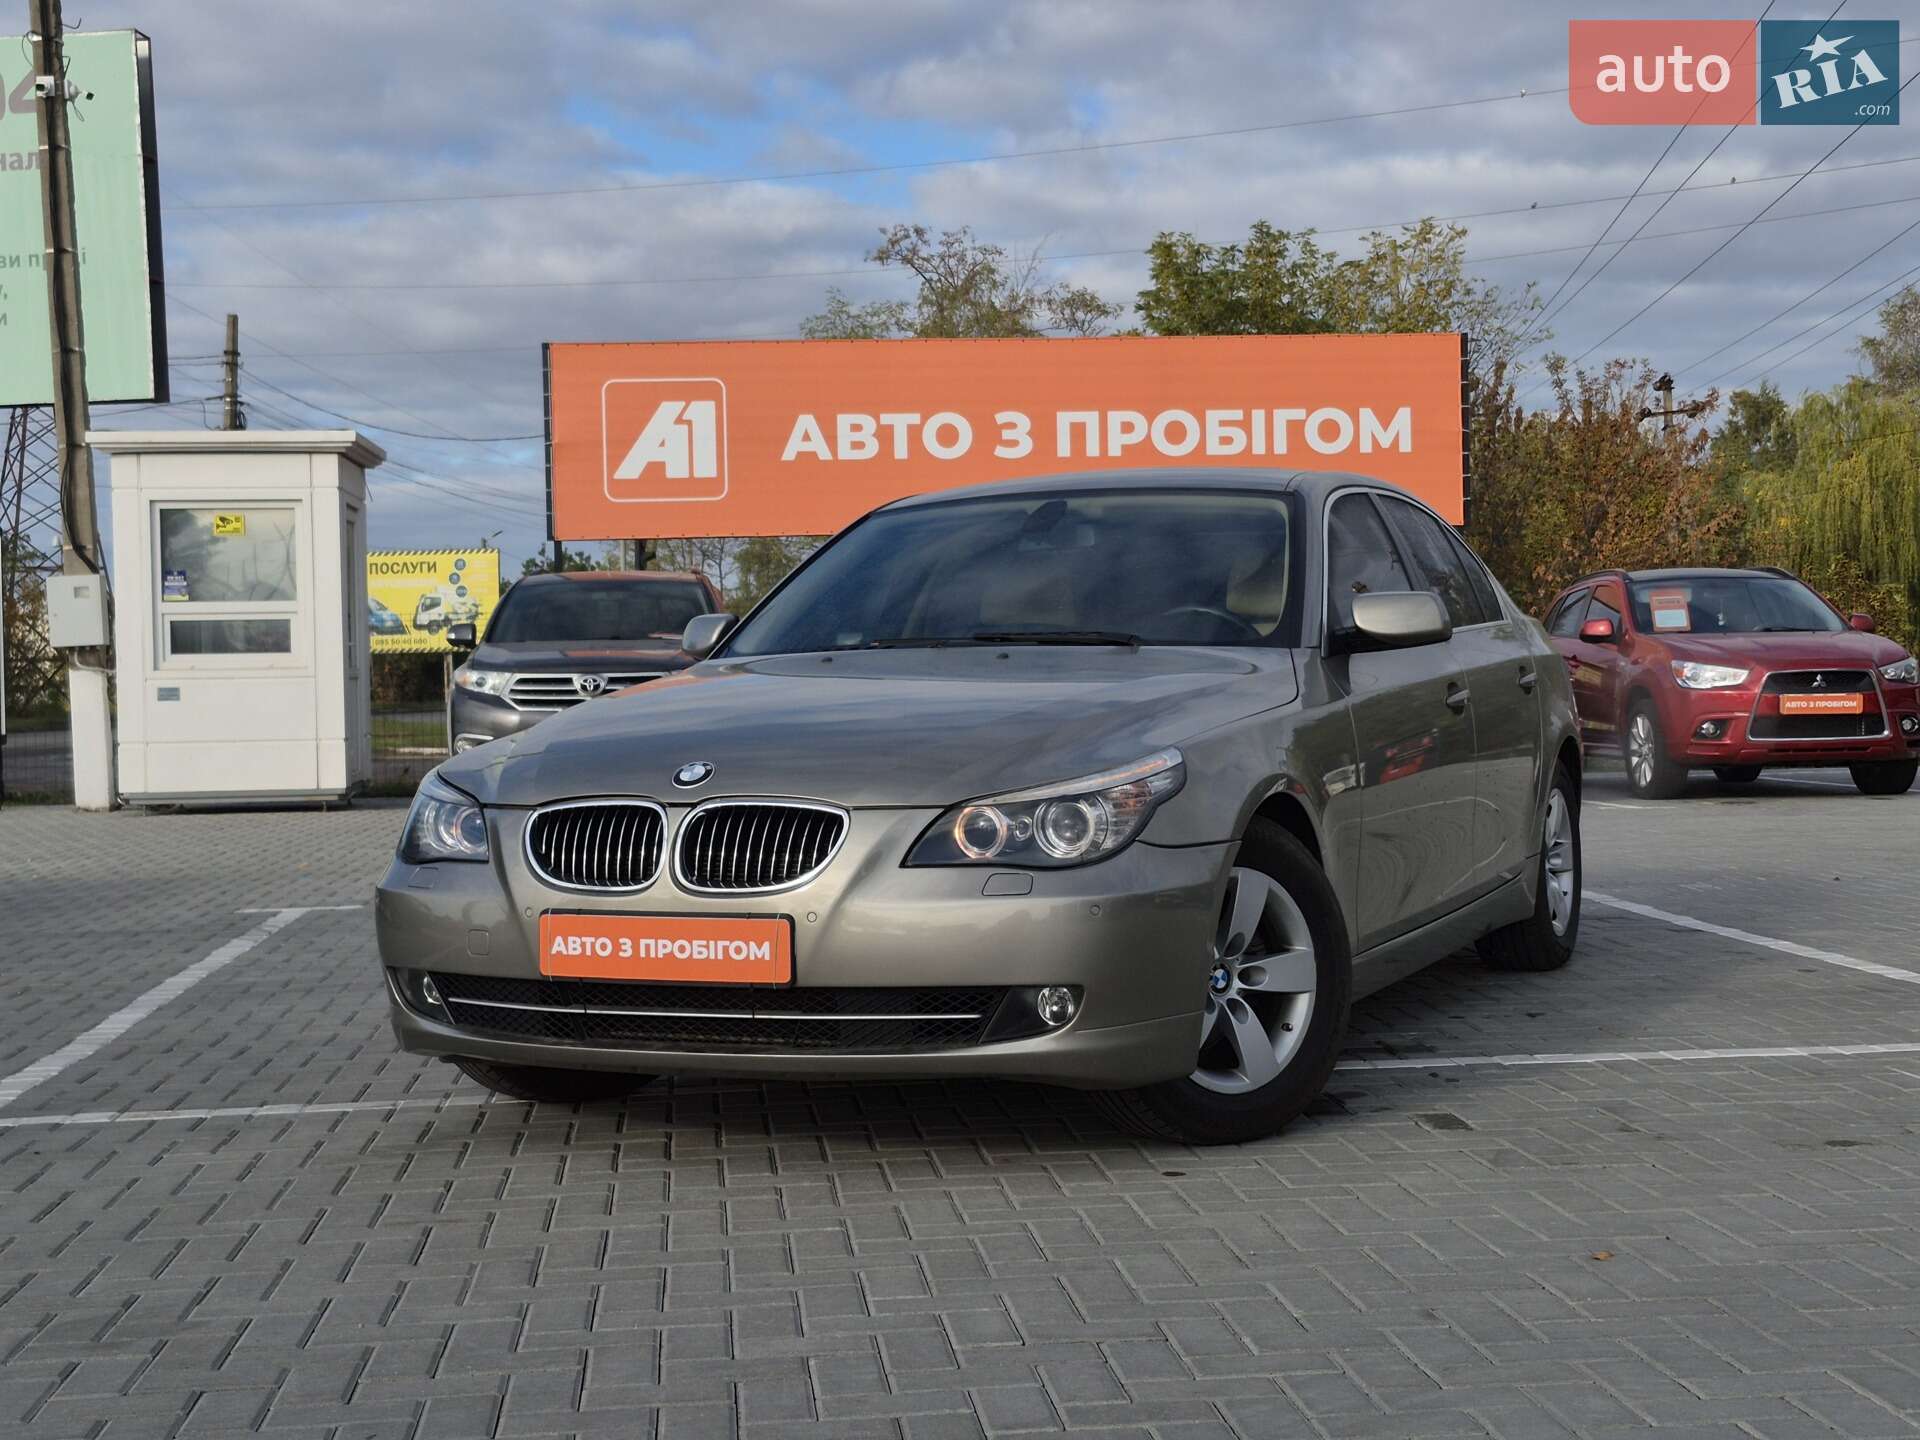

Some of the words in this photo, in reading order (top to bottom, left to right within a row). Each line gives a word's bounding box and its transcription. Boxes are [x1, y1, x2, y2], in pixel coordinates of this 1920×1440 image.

[613, 400, 718, 479] A1
[781, 411, 973, 462] АВТО
[994, 411, 1033, 459] З
[1056, 406, 1413, 459] ПРОБІГОМ
[369, 561, 437, 575] ПОСЛУГИ
[1815, 700, 1857, 708] ПРОБІГОМ
[551, 936, 613, 957] АВТО
[618, 938, 633, 958] З
[639, 938, 771, 961] ПРОБІГОМ
